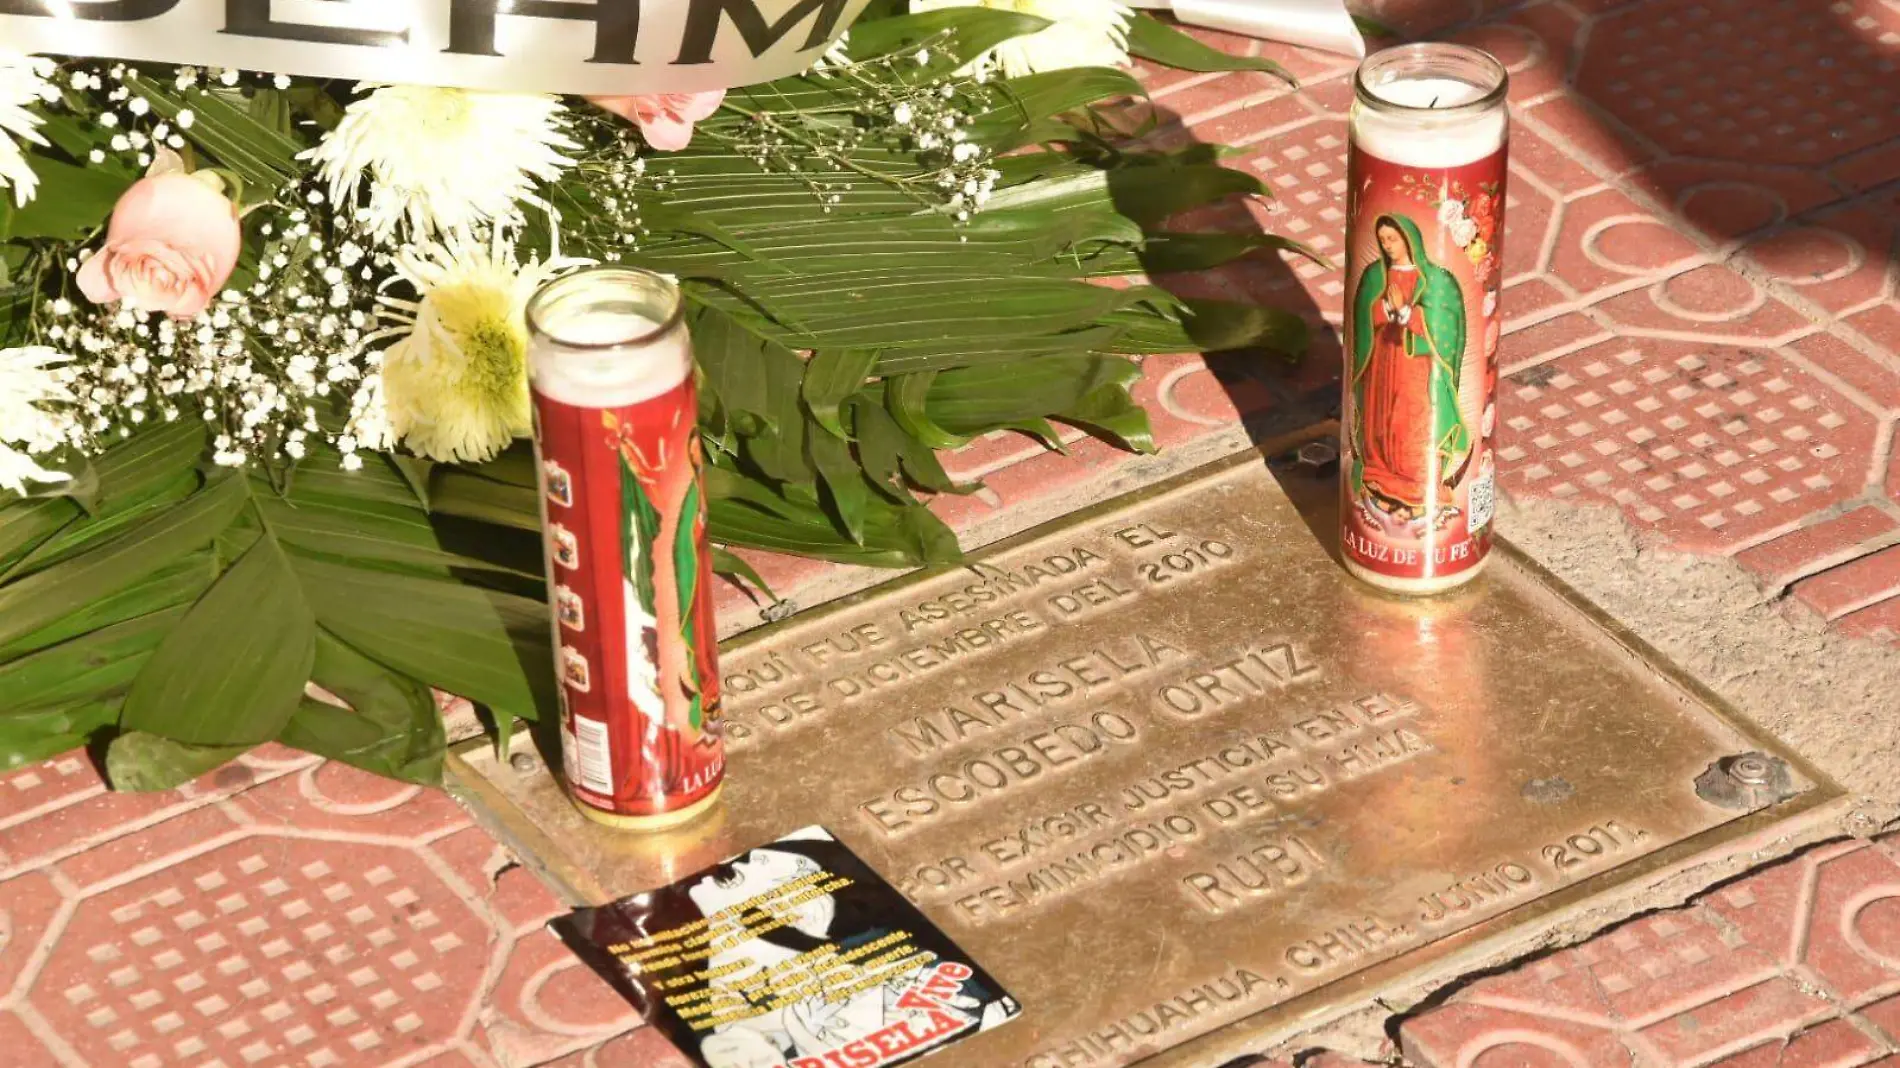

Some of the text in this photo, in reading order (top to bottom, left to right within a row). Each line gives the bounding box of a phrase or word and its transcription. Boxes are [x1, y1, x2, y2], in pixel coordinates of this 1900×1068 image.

[0, 0, 850, 65] HM
[801, 620, 893, 667] FUE
[899, 546, 1106, 634] ASESINADA
[1113, 524, 1178, 550] EL
[1360, 536, 1389, 562] LUZ
[1393, 547, 1417, 565] DE
[759, 692, 824, 726] DE
[828, 610, 1043, 698] DICIEMBRE
[1048, 577, 1131, 616] DEL
[1139, 540, 1236, 585] 2010
[892, 633, 1190, 760] MARISELA
[683, 771, 703, 795] LA
[860, 708, 1138, 836] ESCOBEDO
[979, 803, 1113, 866] EXIGIR
[1121, 733, 1290, 812] JUSTICIA
[1294, 707, 1361, 741] EN
[1353, 692, 1418, 722] EL
[955, 727, 1432, 920] FEMINICIDIO DE SU HIJA
[1418, 861, 1532, 922] JUNIO
[896, 961, 974, 1009] Vive
[772, 1010, 965, 1068] RISELA
